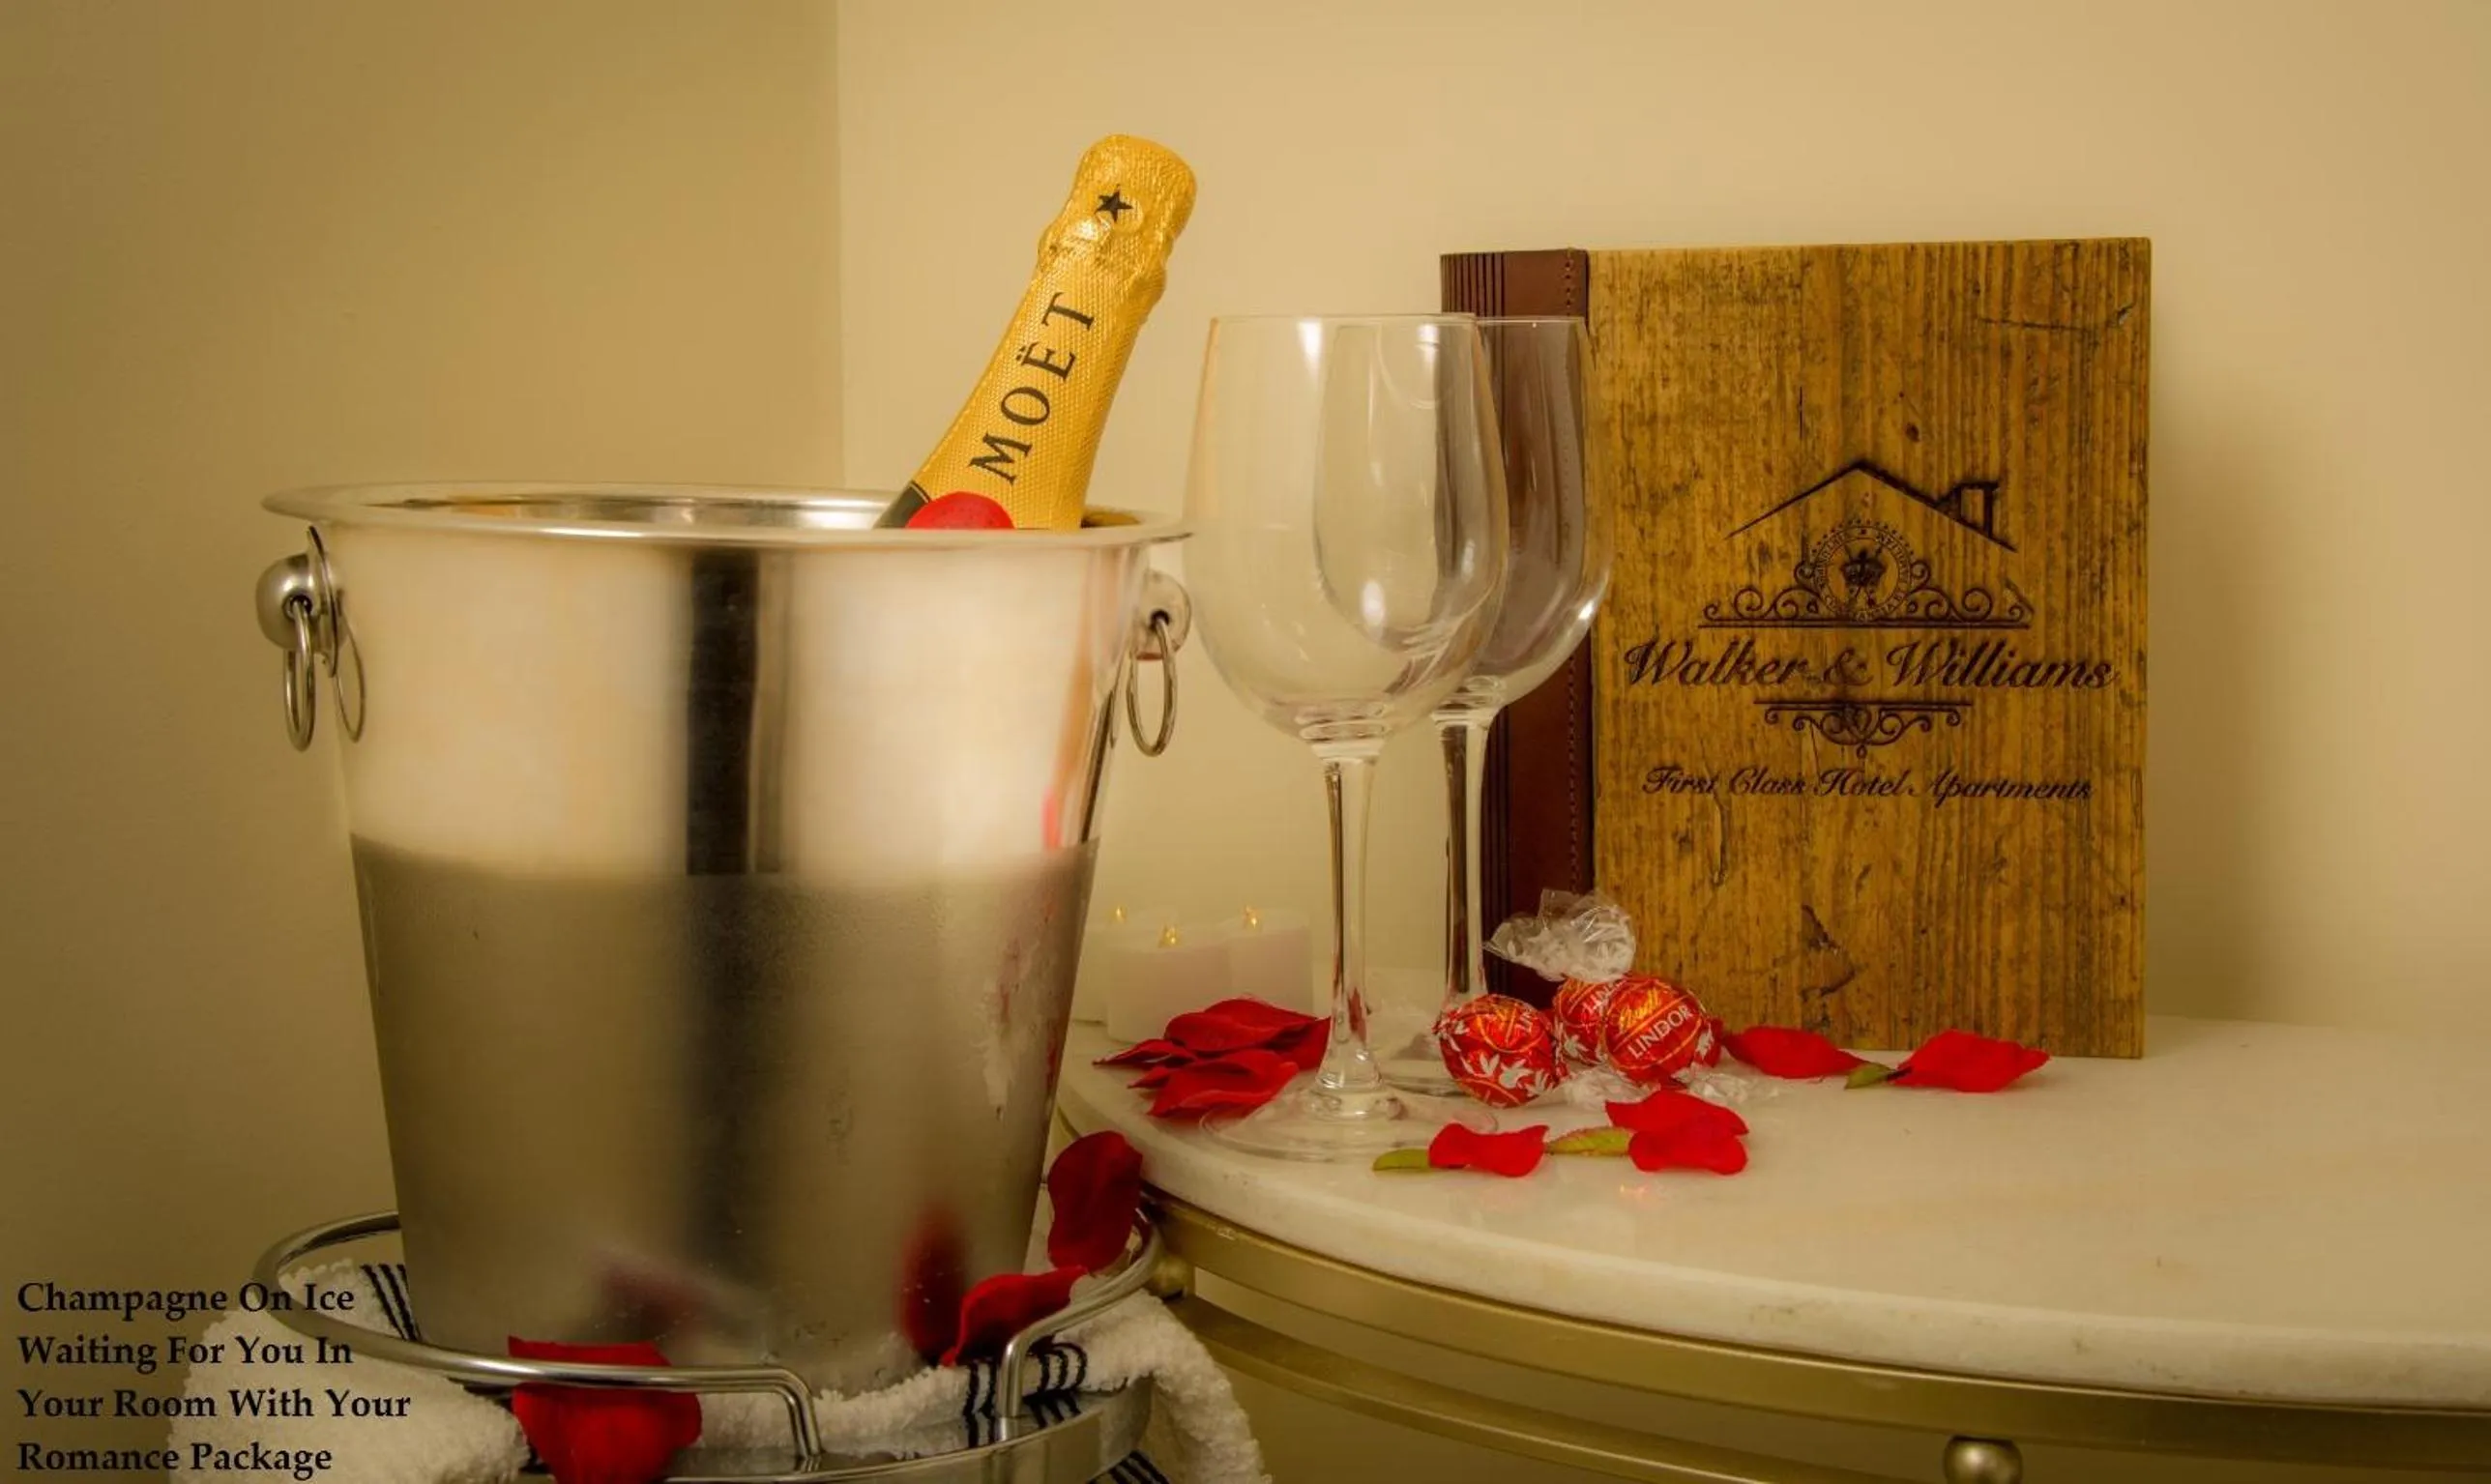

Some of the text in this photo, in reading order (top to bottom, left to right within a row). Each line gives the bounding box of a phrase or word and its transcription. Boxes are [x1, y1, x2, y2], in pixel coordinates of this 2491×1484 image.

[968, 292, 1096, 485] MOËT
[1624, 636, 2116, 688] Walker & Williams
[1642, 764, 2095, 809] First Class Hotel Apartments
[1626, 1004, 1693, 1060] LINDOR
